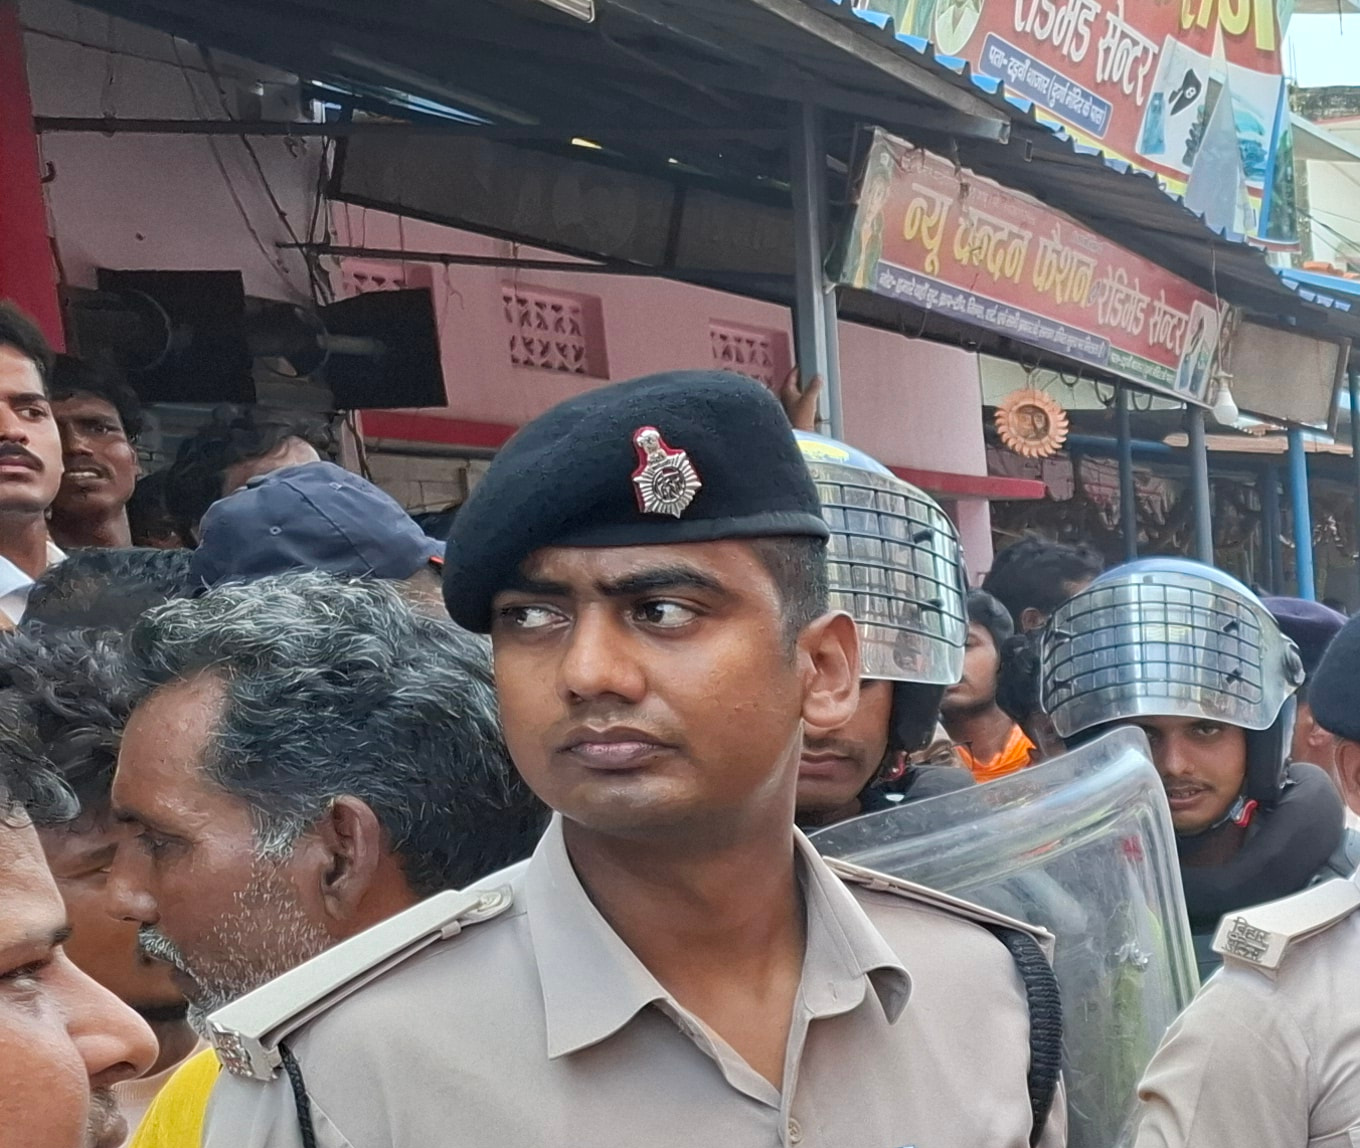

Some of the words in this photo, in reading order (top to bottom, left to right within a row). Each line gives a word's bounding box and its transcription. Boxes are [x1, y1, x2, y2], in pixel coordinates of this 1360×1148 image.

[904, 183, 953, 276] न्यू
[1098, 265, 1151, 336] रेडिमेड
[1149, 288, 1190, 356] सेन्टर
